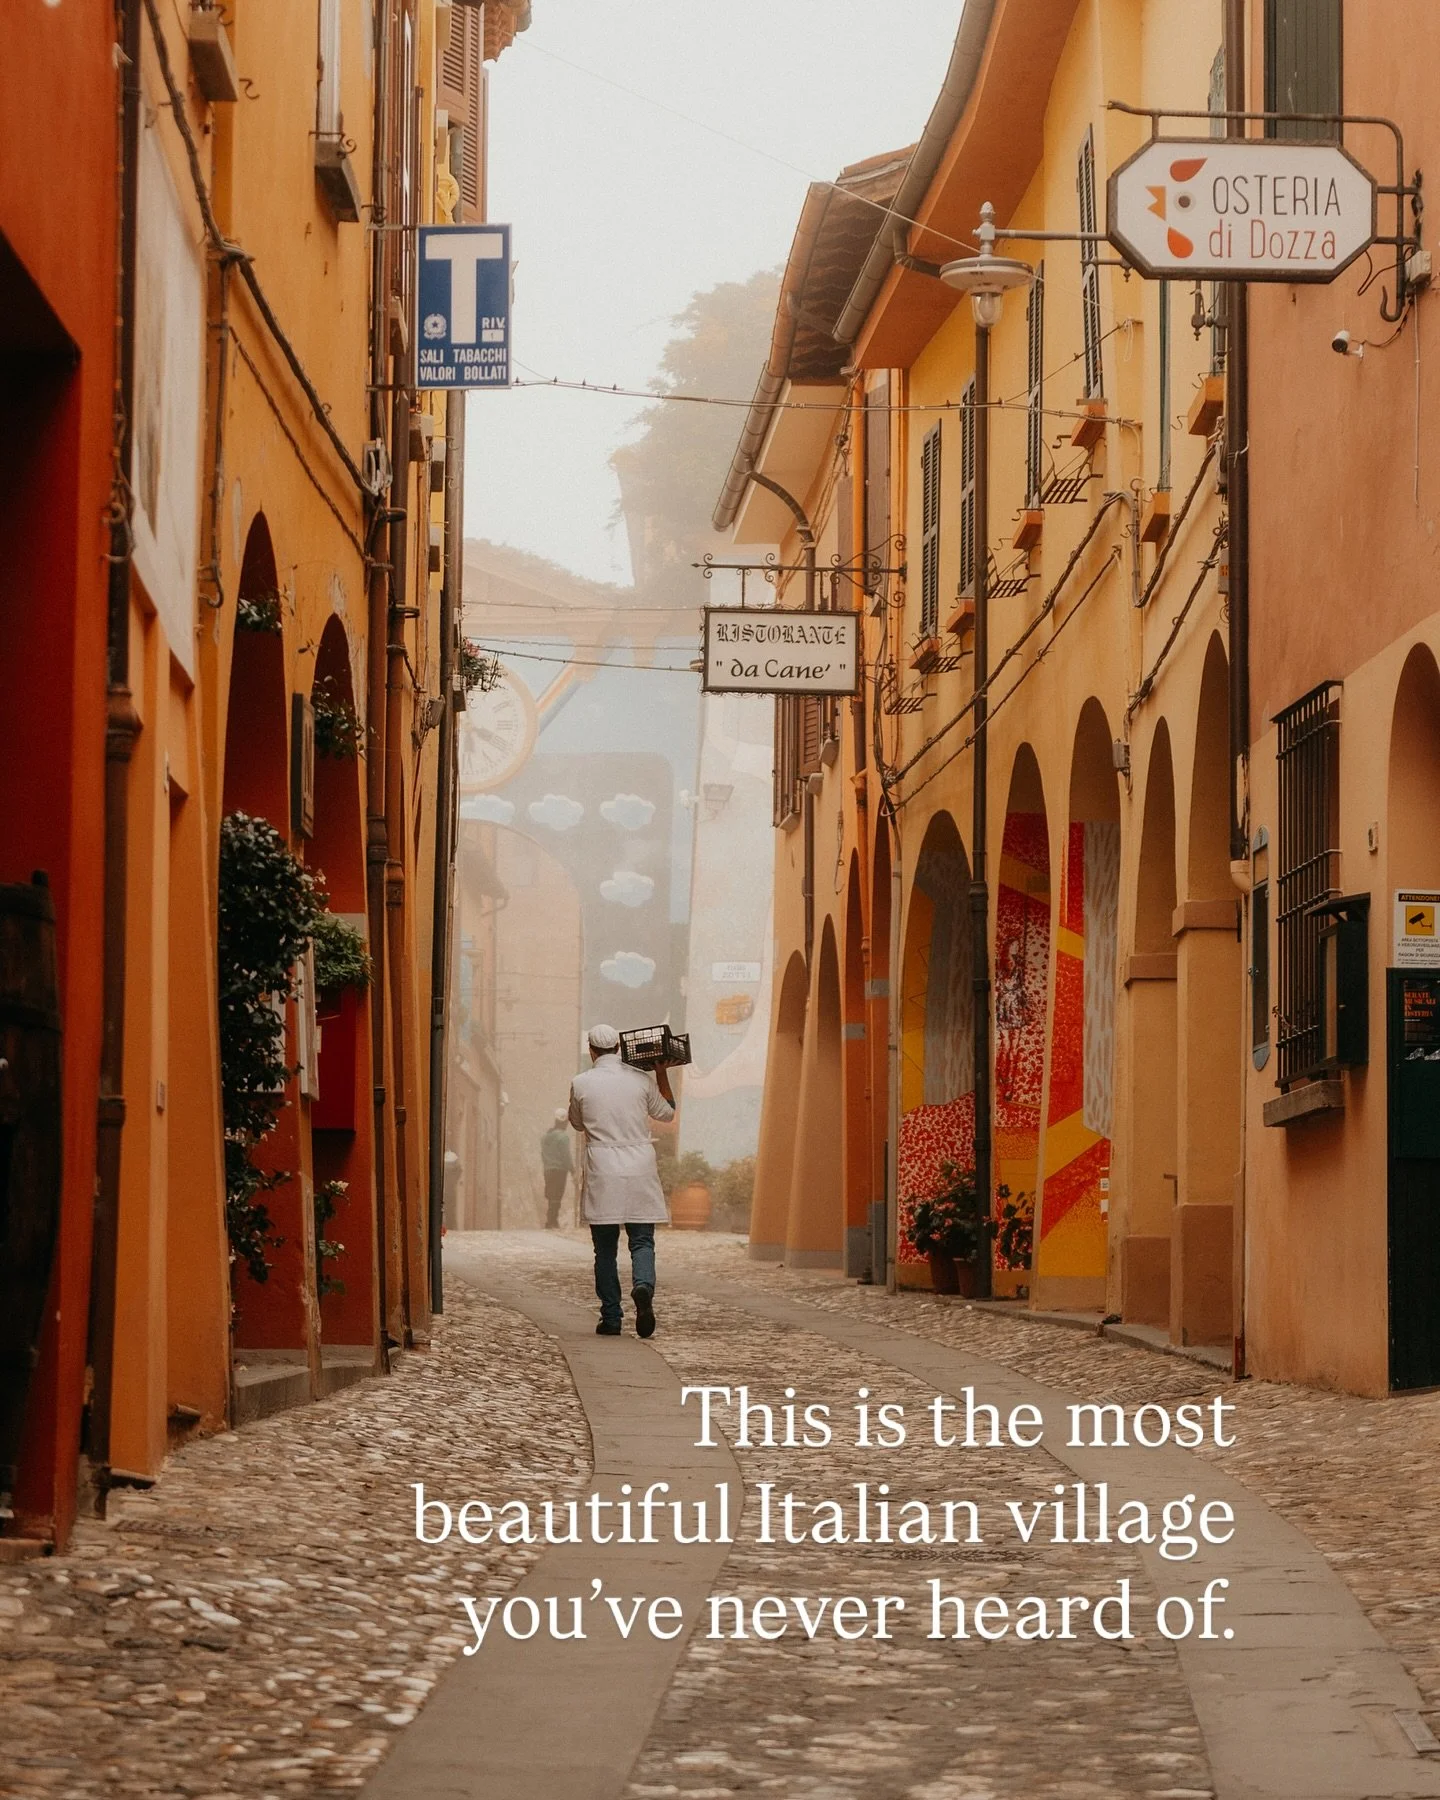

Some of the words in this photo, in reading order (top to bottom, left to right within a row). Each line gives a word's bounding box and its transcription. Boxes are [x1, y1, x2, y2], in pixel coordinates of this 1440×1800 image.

[1212, 174, 1341, 217] OSTERIA
[1208, 218, 1233, 259] di
[1250, 218, 1337, 261] Dozza
[425, 233, 504, 345] T
[481, 316, 506, 329] RIV.
[420, 348, 444, 364] SALI
[453, 347, 507, 364] TABACCHI
[420, 366, 456, 381] VALORI
[463, 365, 507, 381] BOLLATI
[716, 623, 847, 645] RISTORANTE
[730, 658, 760, 678] da
